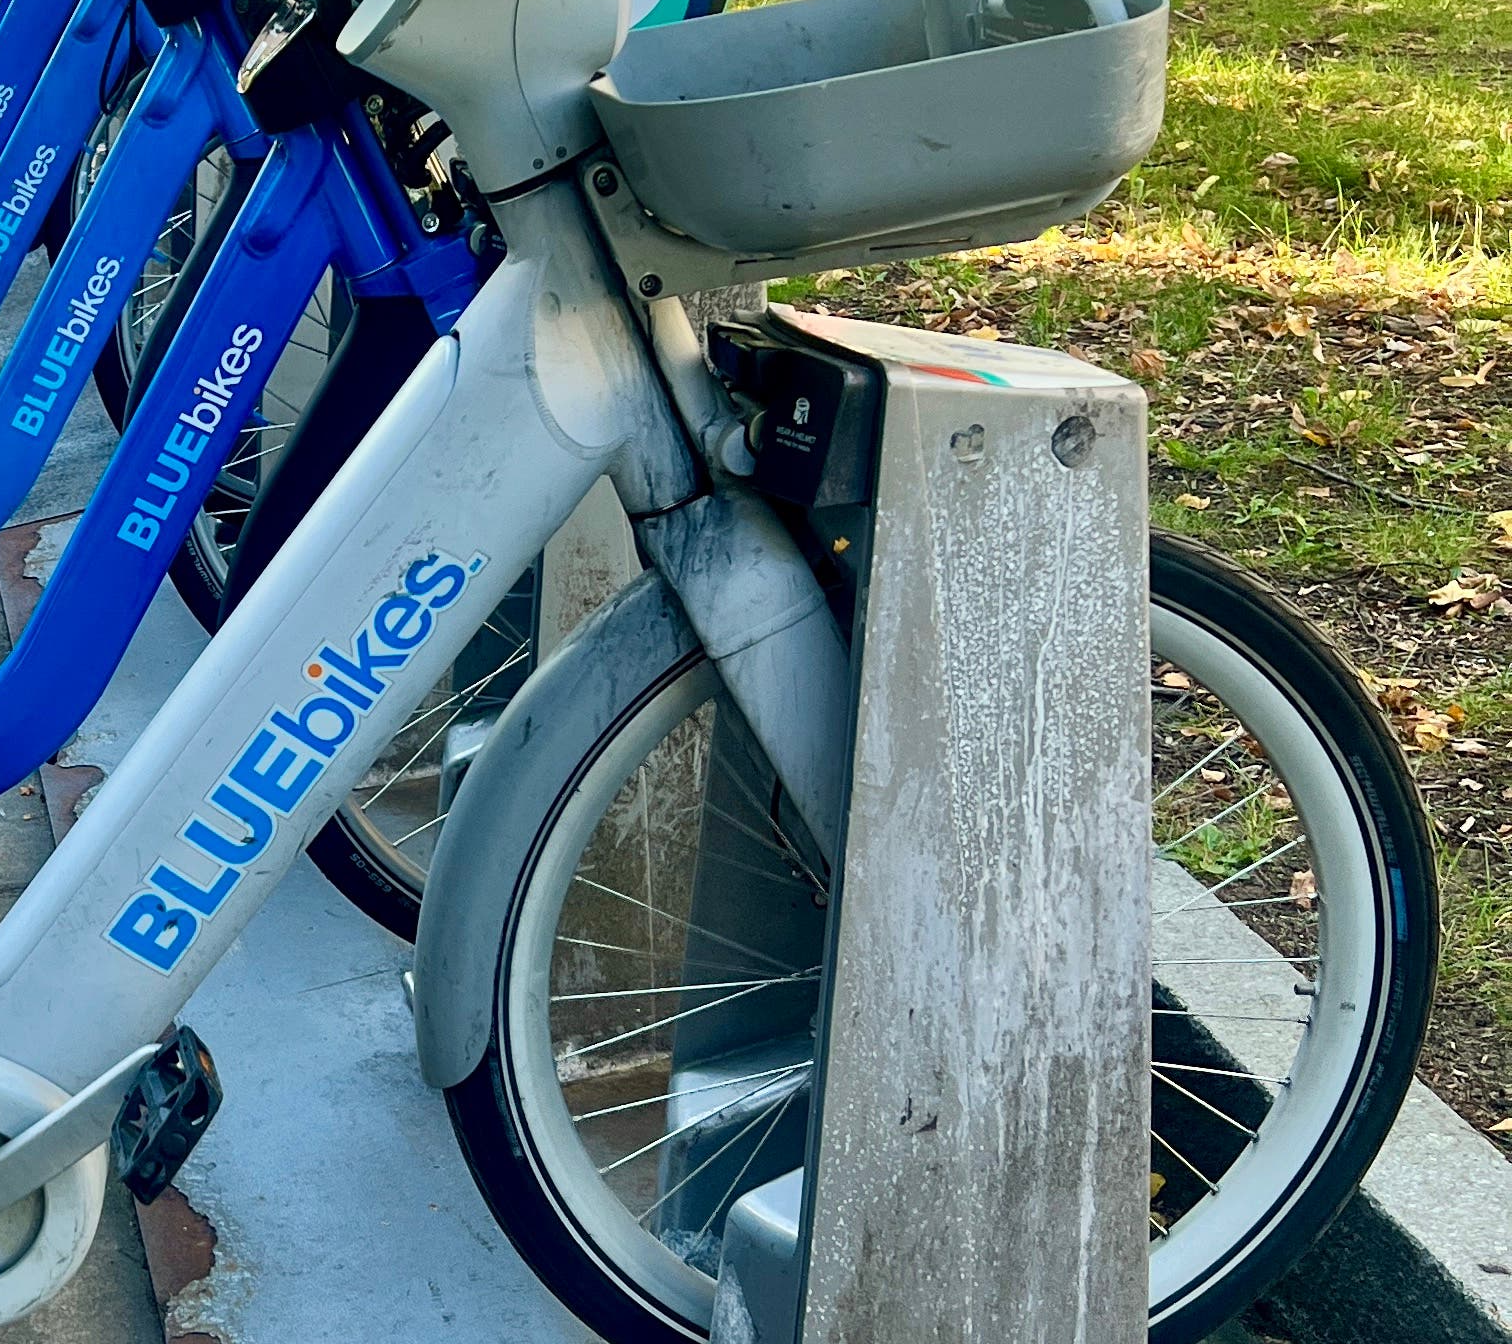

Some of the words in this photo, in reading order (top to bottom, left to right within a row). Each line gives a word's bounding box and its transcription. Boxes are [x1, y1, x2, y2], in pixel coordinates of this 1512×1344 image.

[11, 256, 119, 437] BLUEbikes
[117, 323, 263, 552] BLUEbikes
[107, 554, 468, 971] BLUEbikes
